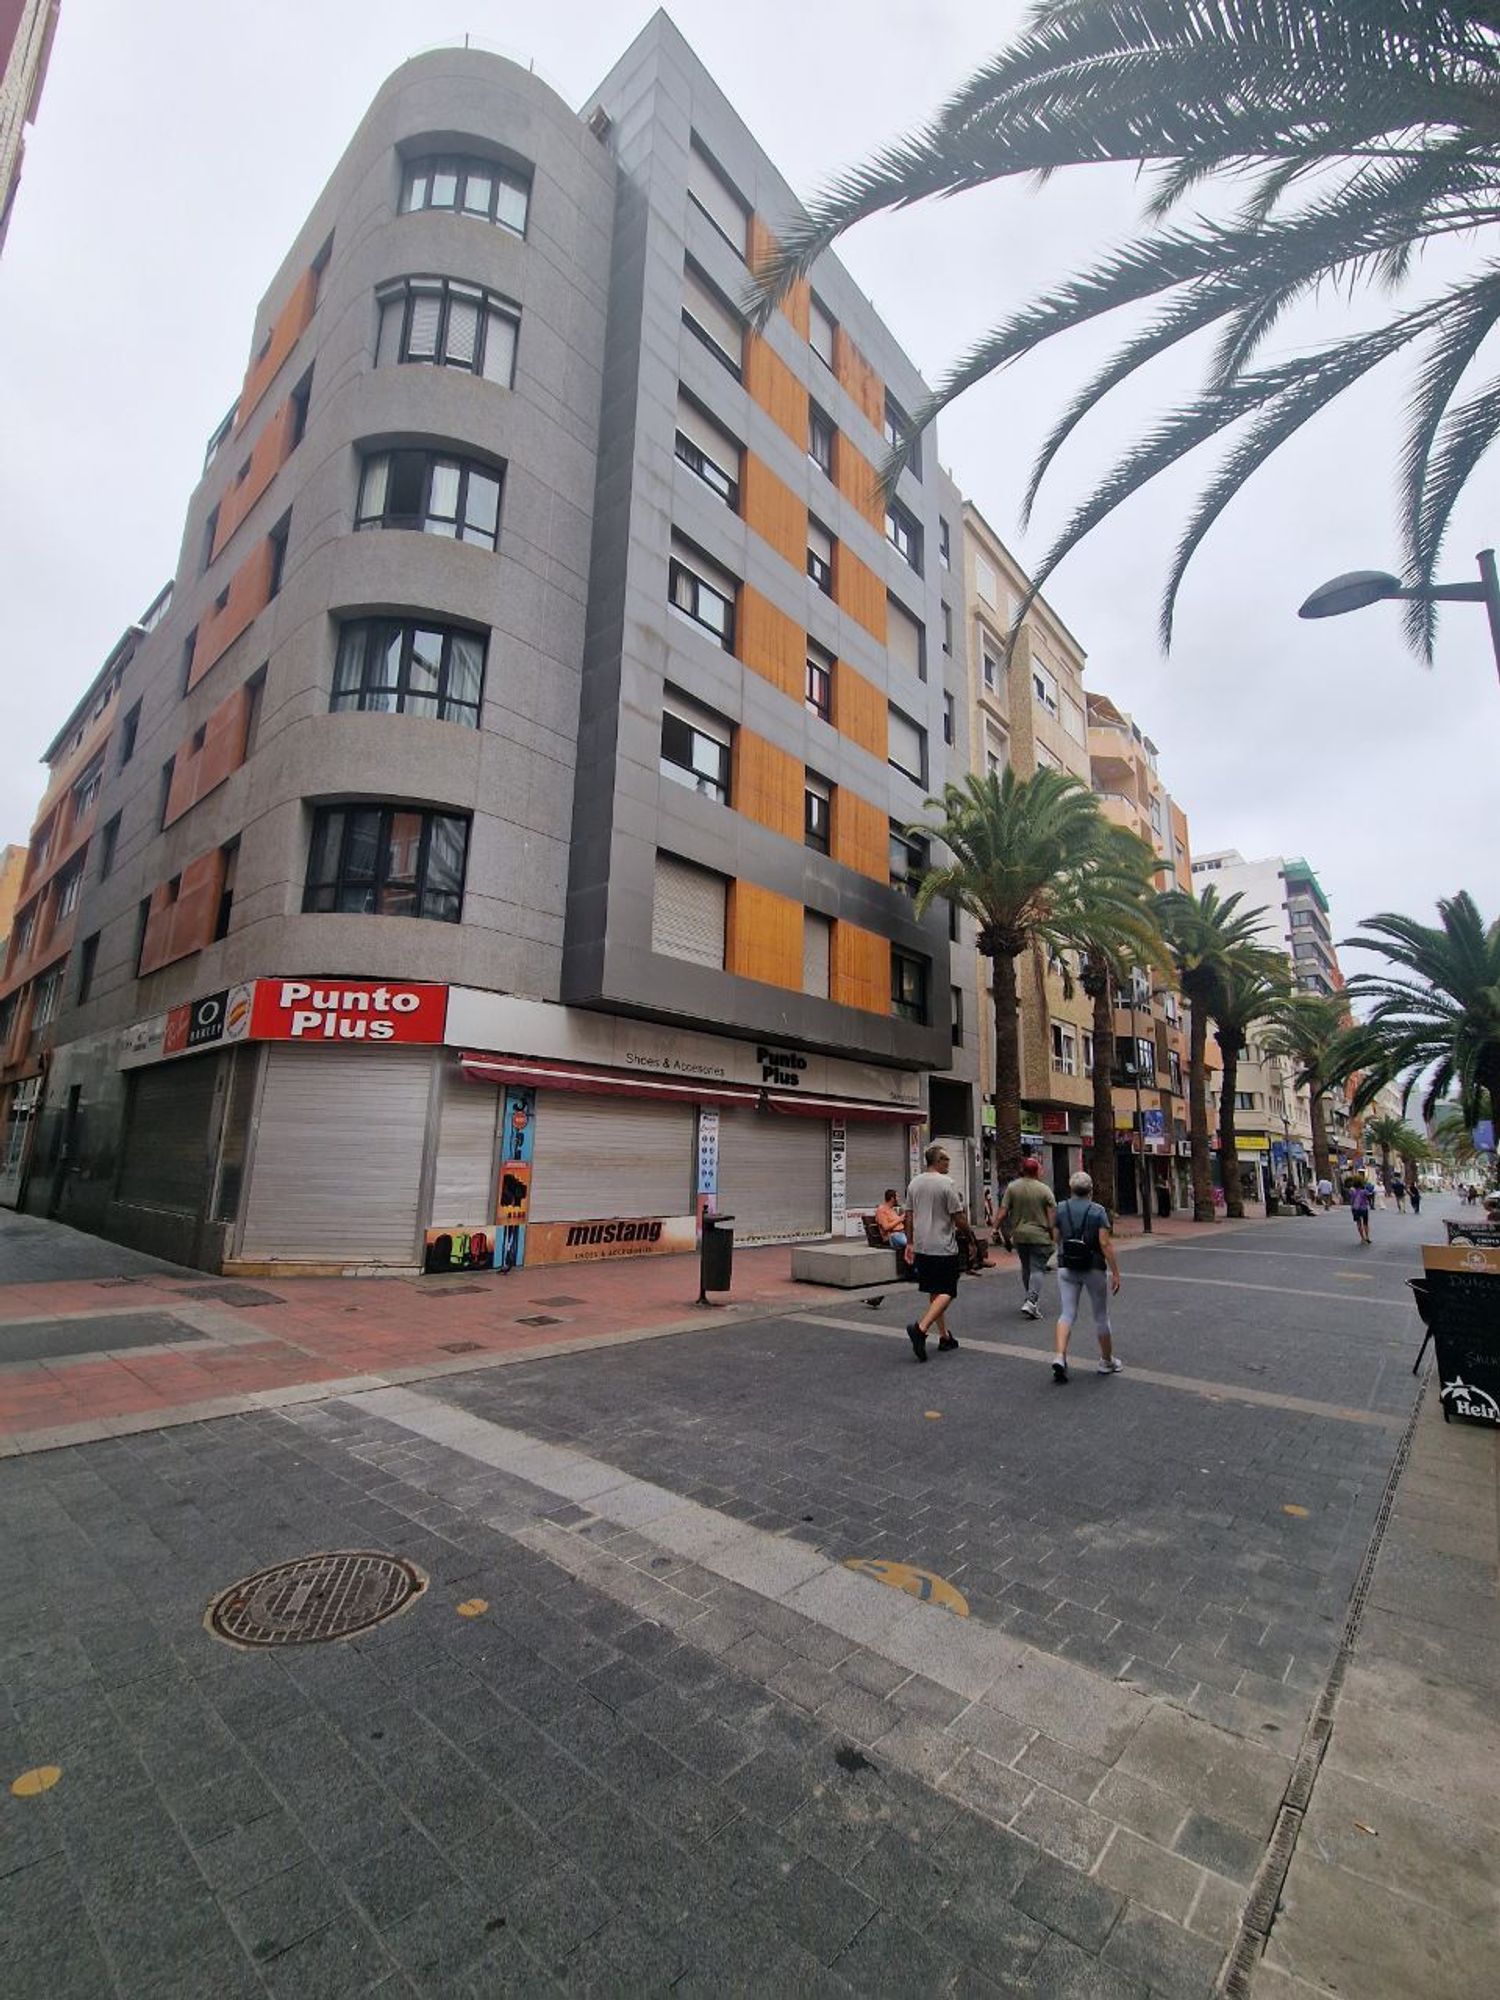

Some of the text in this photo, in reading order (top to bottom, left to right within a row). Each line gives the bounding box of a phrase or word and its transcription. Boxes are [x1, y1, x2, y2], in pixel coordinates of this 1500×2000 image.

[279, 982, 420, 1013] Punto
[291, 1011, 395, 1039] Plus
[626, 1053, 660, 1068] Shoes
[663, 1057, 670, 1068] &
[757, 1047, 807, 1070] Punto
[762, 1065, 800, 1086] Plus
[566, 1221, 662, 1246] mustang
